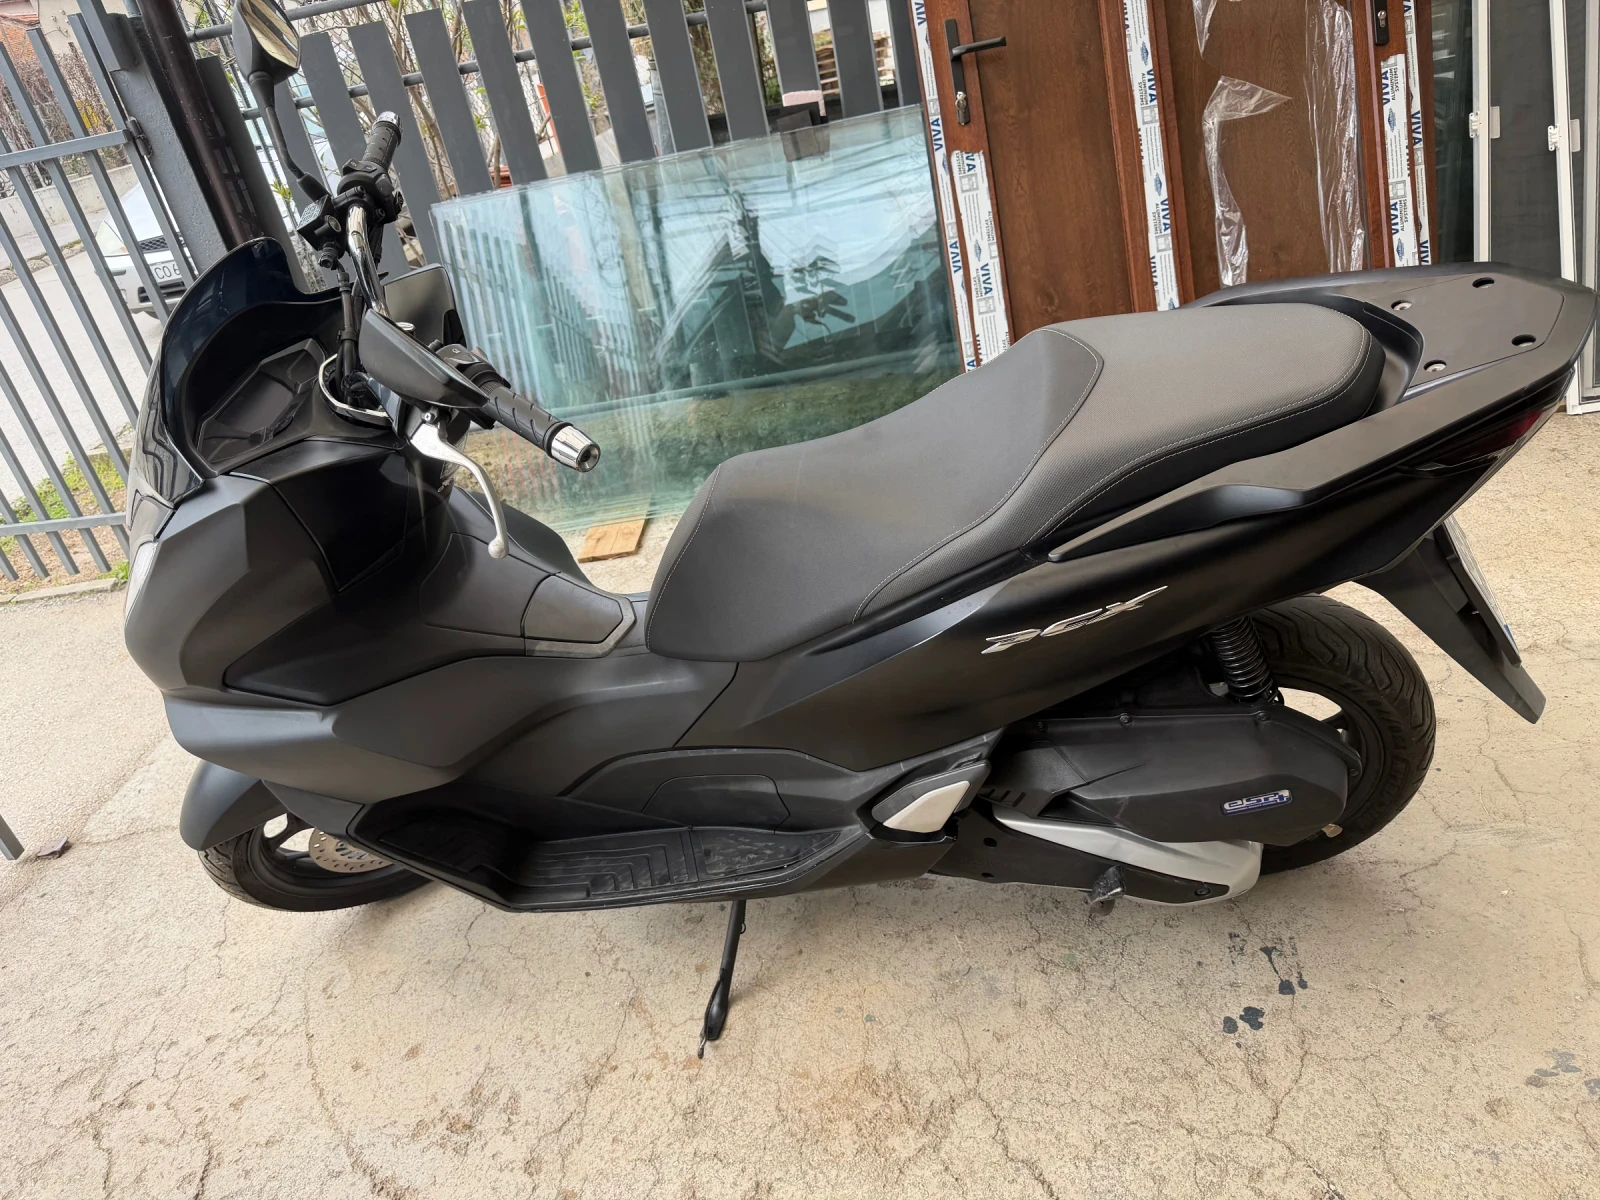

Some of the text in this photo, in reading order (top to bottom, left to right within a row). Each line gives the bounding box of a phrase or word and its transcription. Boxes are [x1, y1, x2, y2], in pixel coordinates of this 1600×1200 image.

[930, 117, 944, 152] VIVA
[1411, 110, 1422, 147] VIVA
[949, 240, 962, 274] VIVA
[980, 263, 993, 296] VIVA
